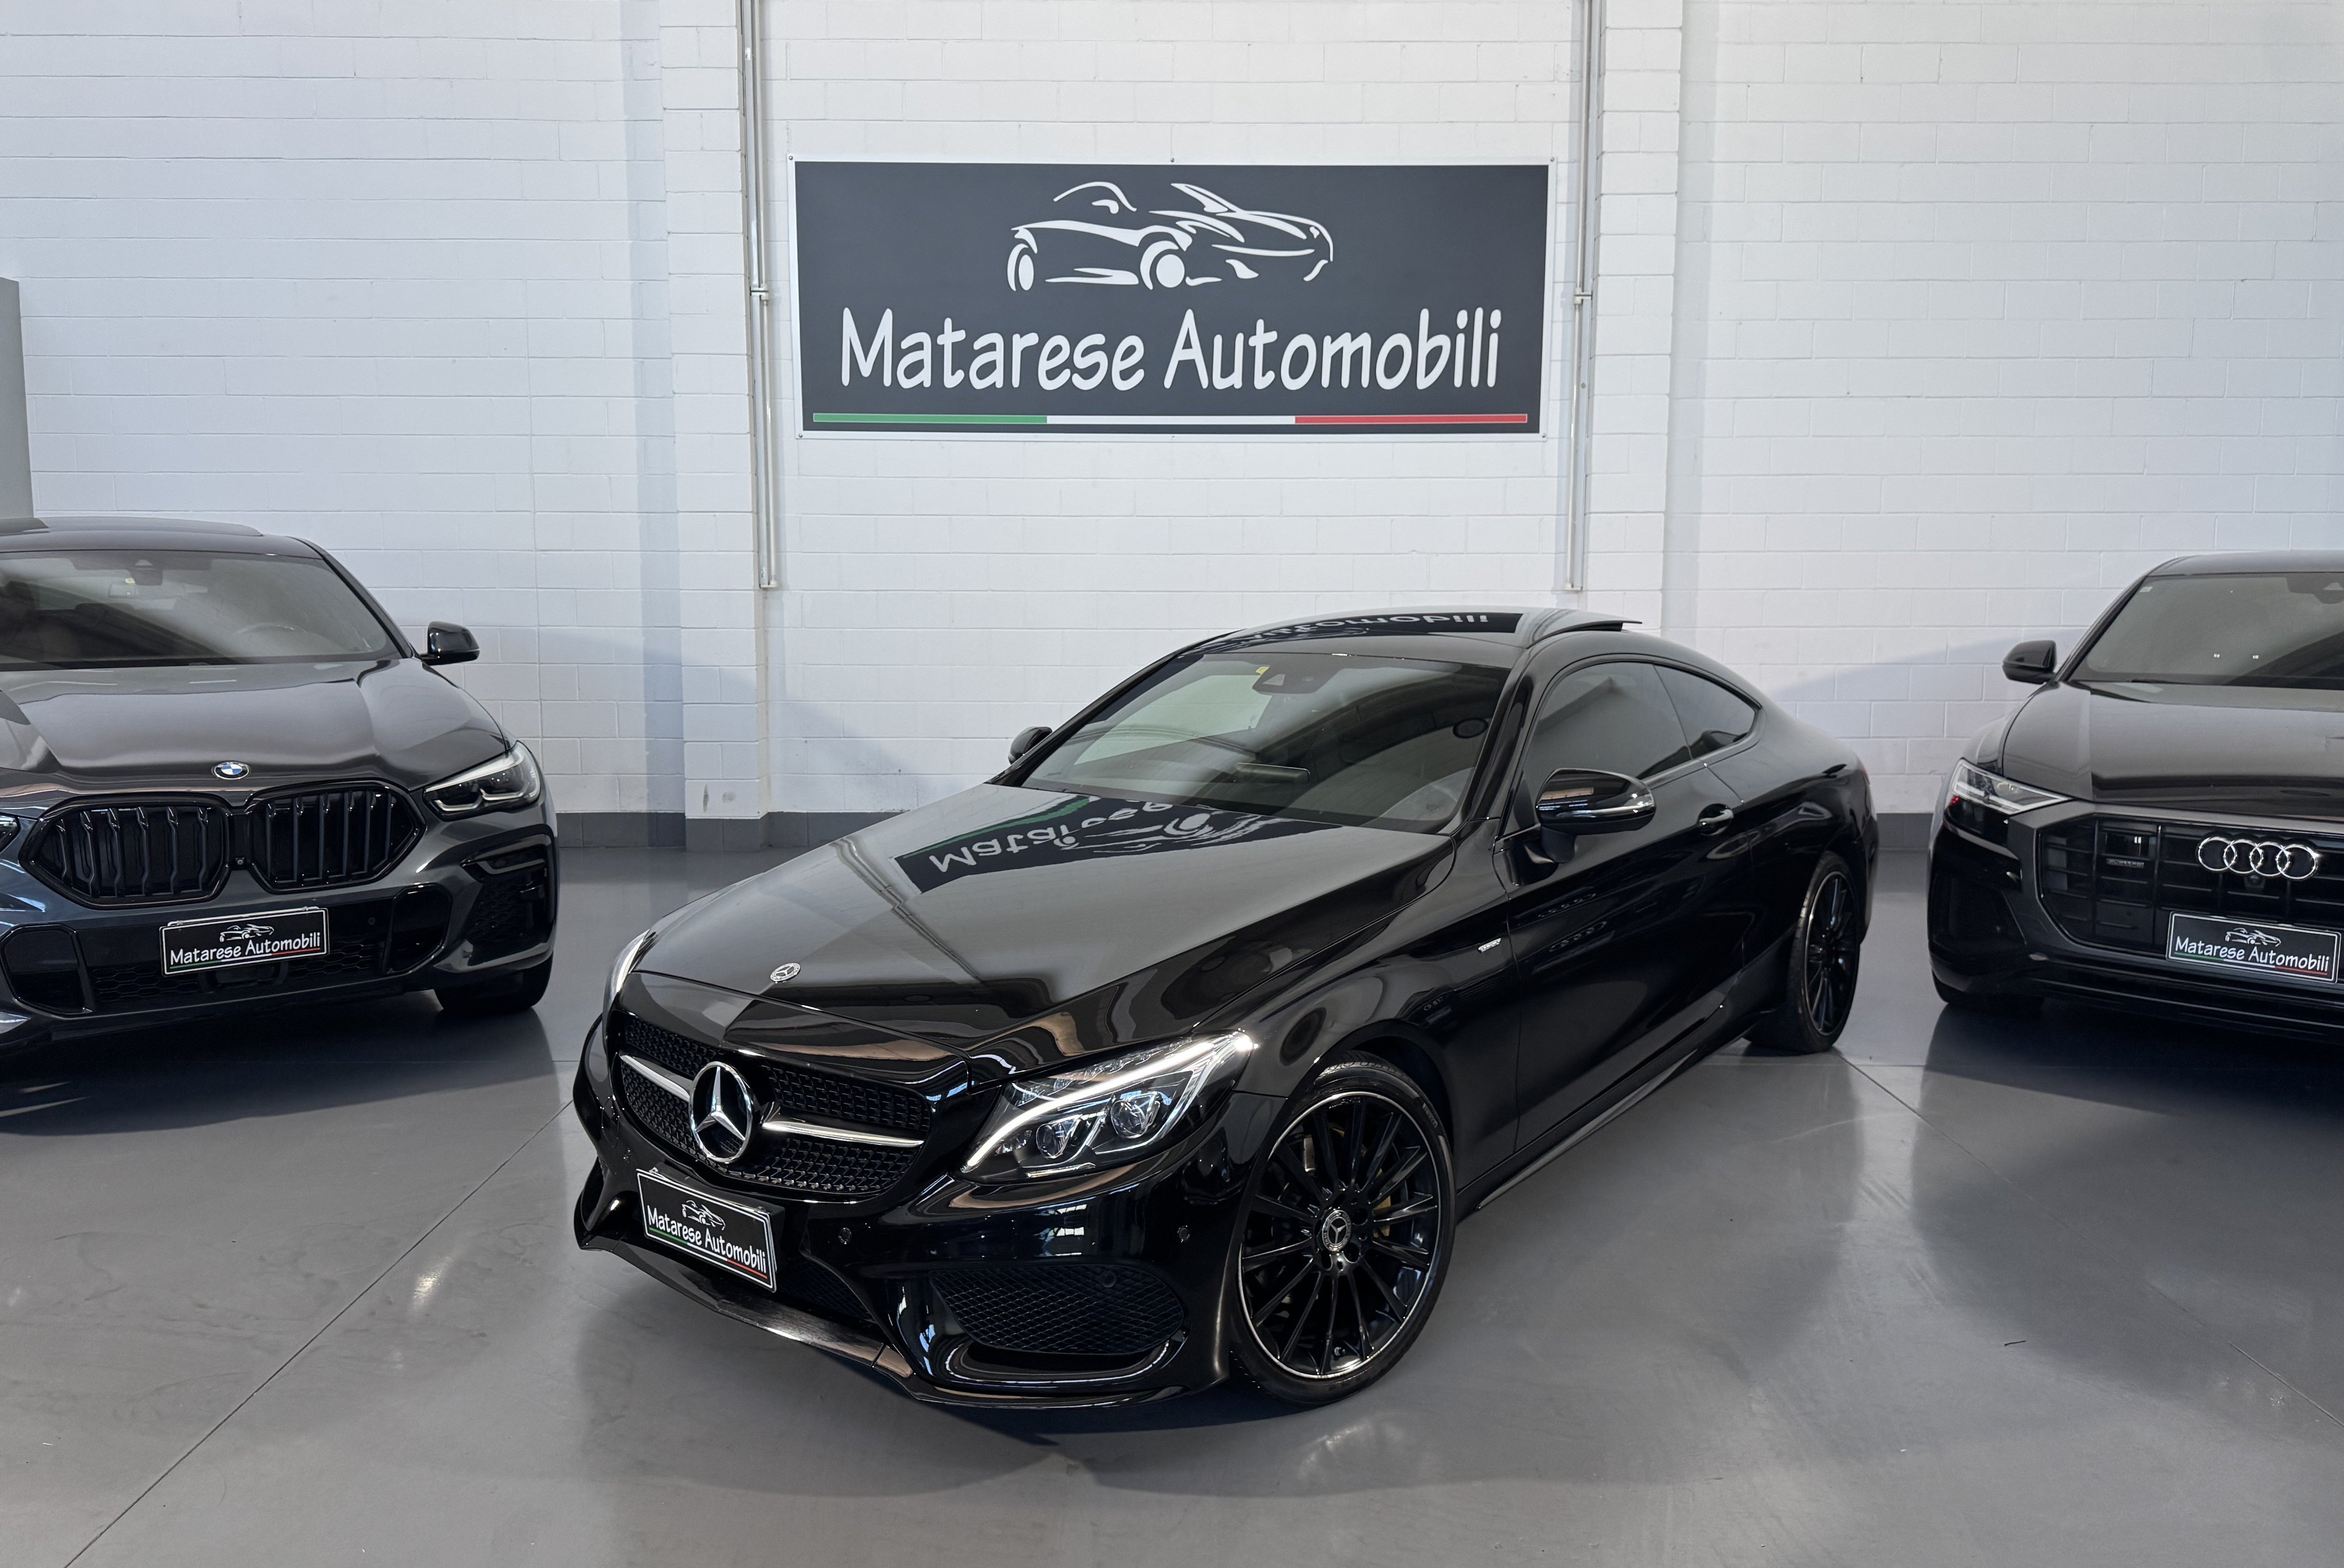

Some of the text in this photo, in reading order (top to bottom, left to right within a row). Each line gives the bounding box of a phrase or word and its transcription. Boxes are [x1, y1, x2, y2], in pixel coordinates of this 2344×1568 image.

[842, 307, 1502, 391] Matarese Automobili
[170, 932, 320, 966] Matarese Automobili
[2175, 936, 2330, 972] Matarese Automobili
[647, 1205, 767, 1273] Matarese Automobili
